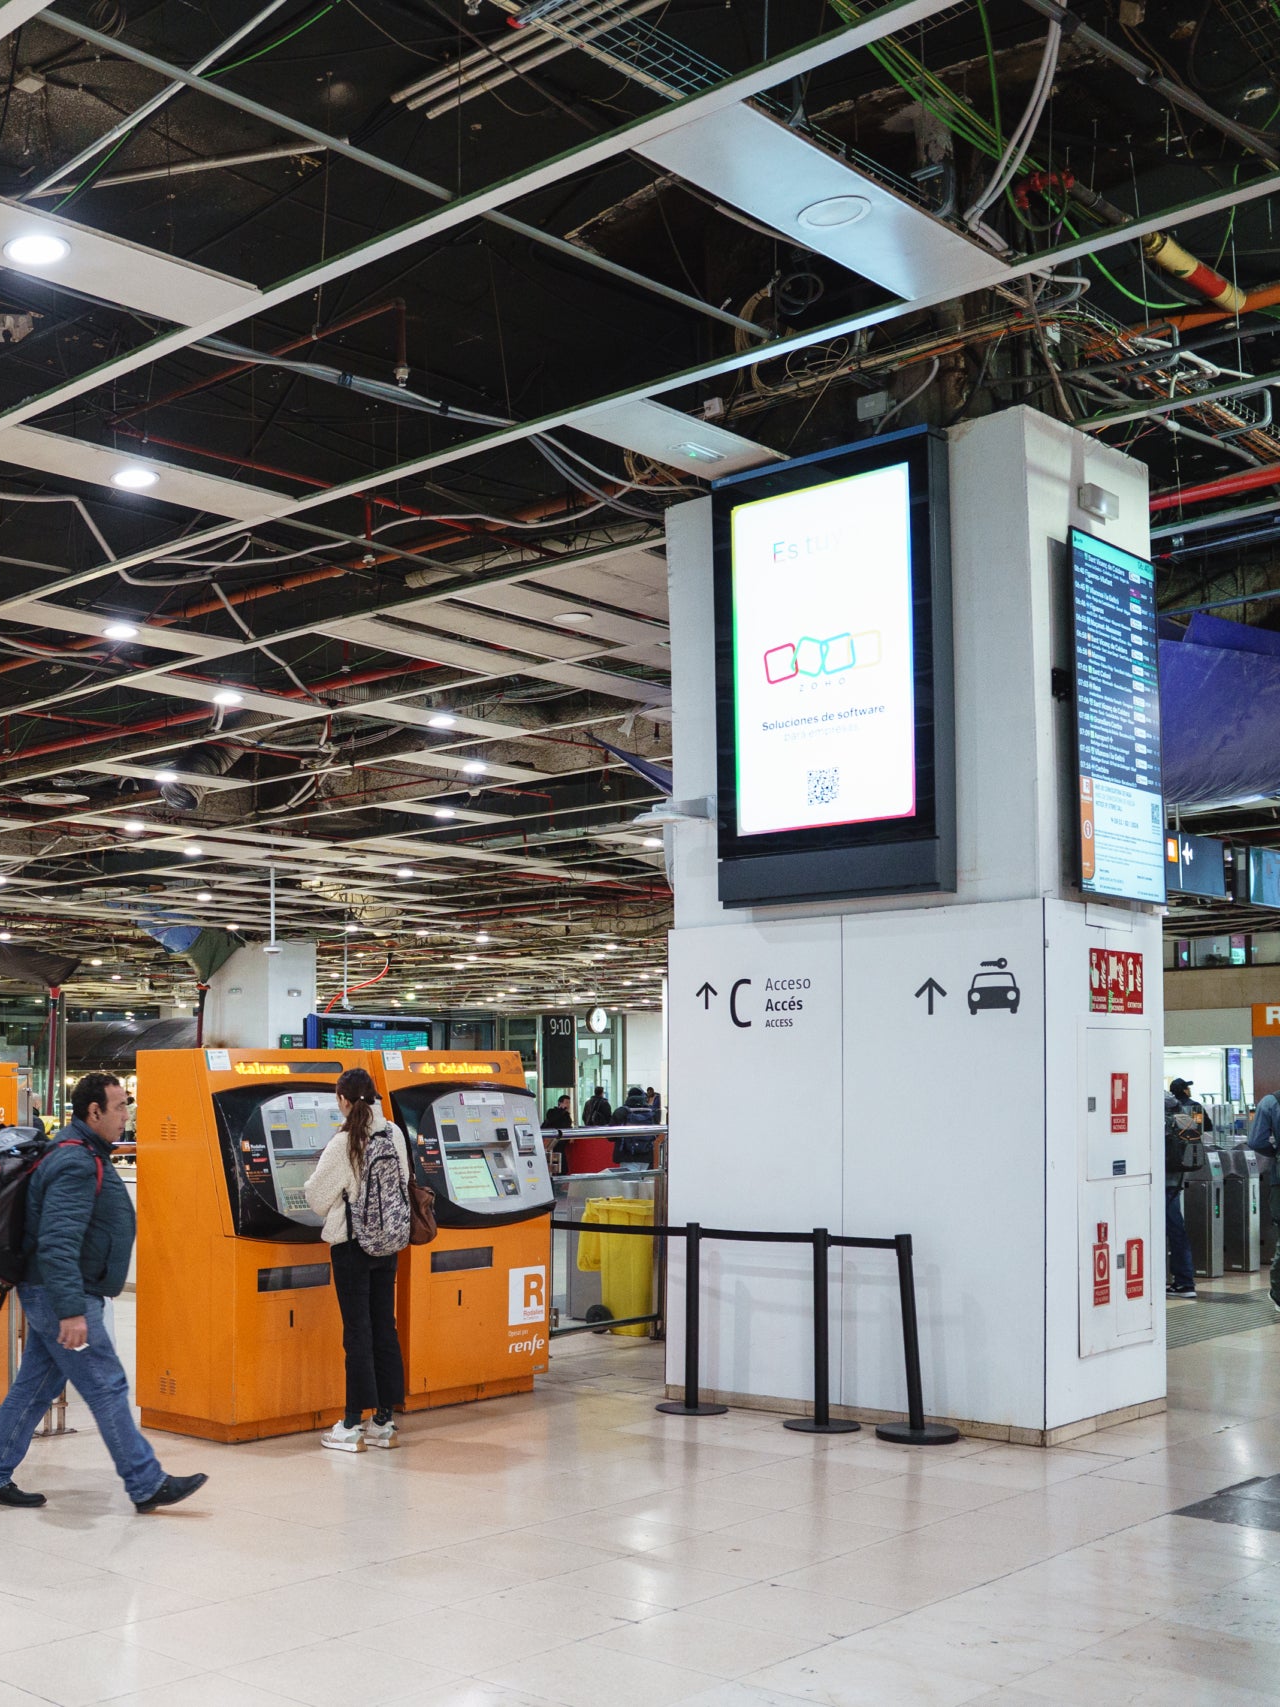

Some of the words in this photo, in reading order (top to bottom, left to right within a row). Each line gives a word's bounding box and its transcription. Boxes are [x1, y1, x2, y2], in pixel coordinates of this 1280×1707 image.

[762, 714, 819, 732] Soluciones
[821, 711, 835, 723] de
[837, 704, 885, 721] software
[765, 977, 811, 992] Acceso
[730, 978, 752, 1028] C
[765, 996, 803, 1013] Accés
[765, 1018, 794, 1029] ACCESS
[1266, 1006, 1280, 1024] R
[234, 1062, 290, 1074] talunya
[422, 1062, 435, 1074] de
[439, 1062, 493, 1074] Catalunya
[524, 1273, 544, 1308] R
[508, 1334, 545, 1356] renfe
